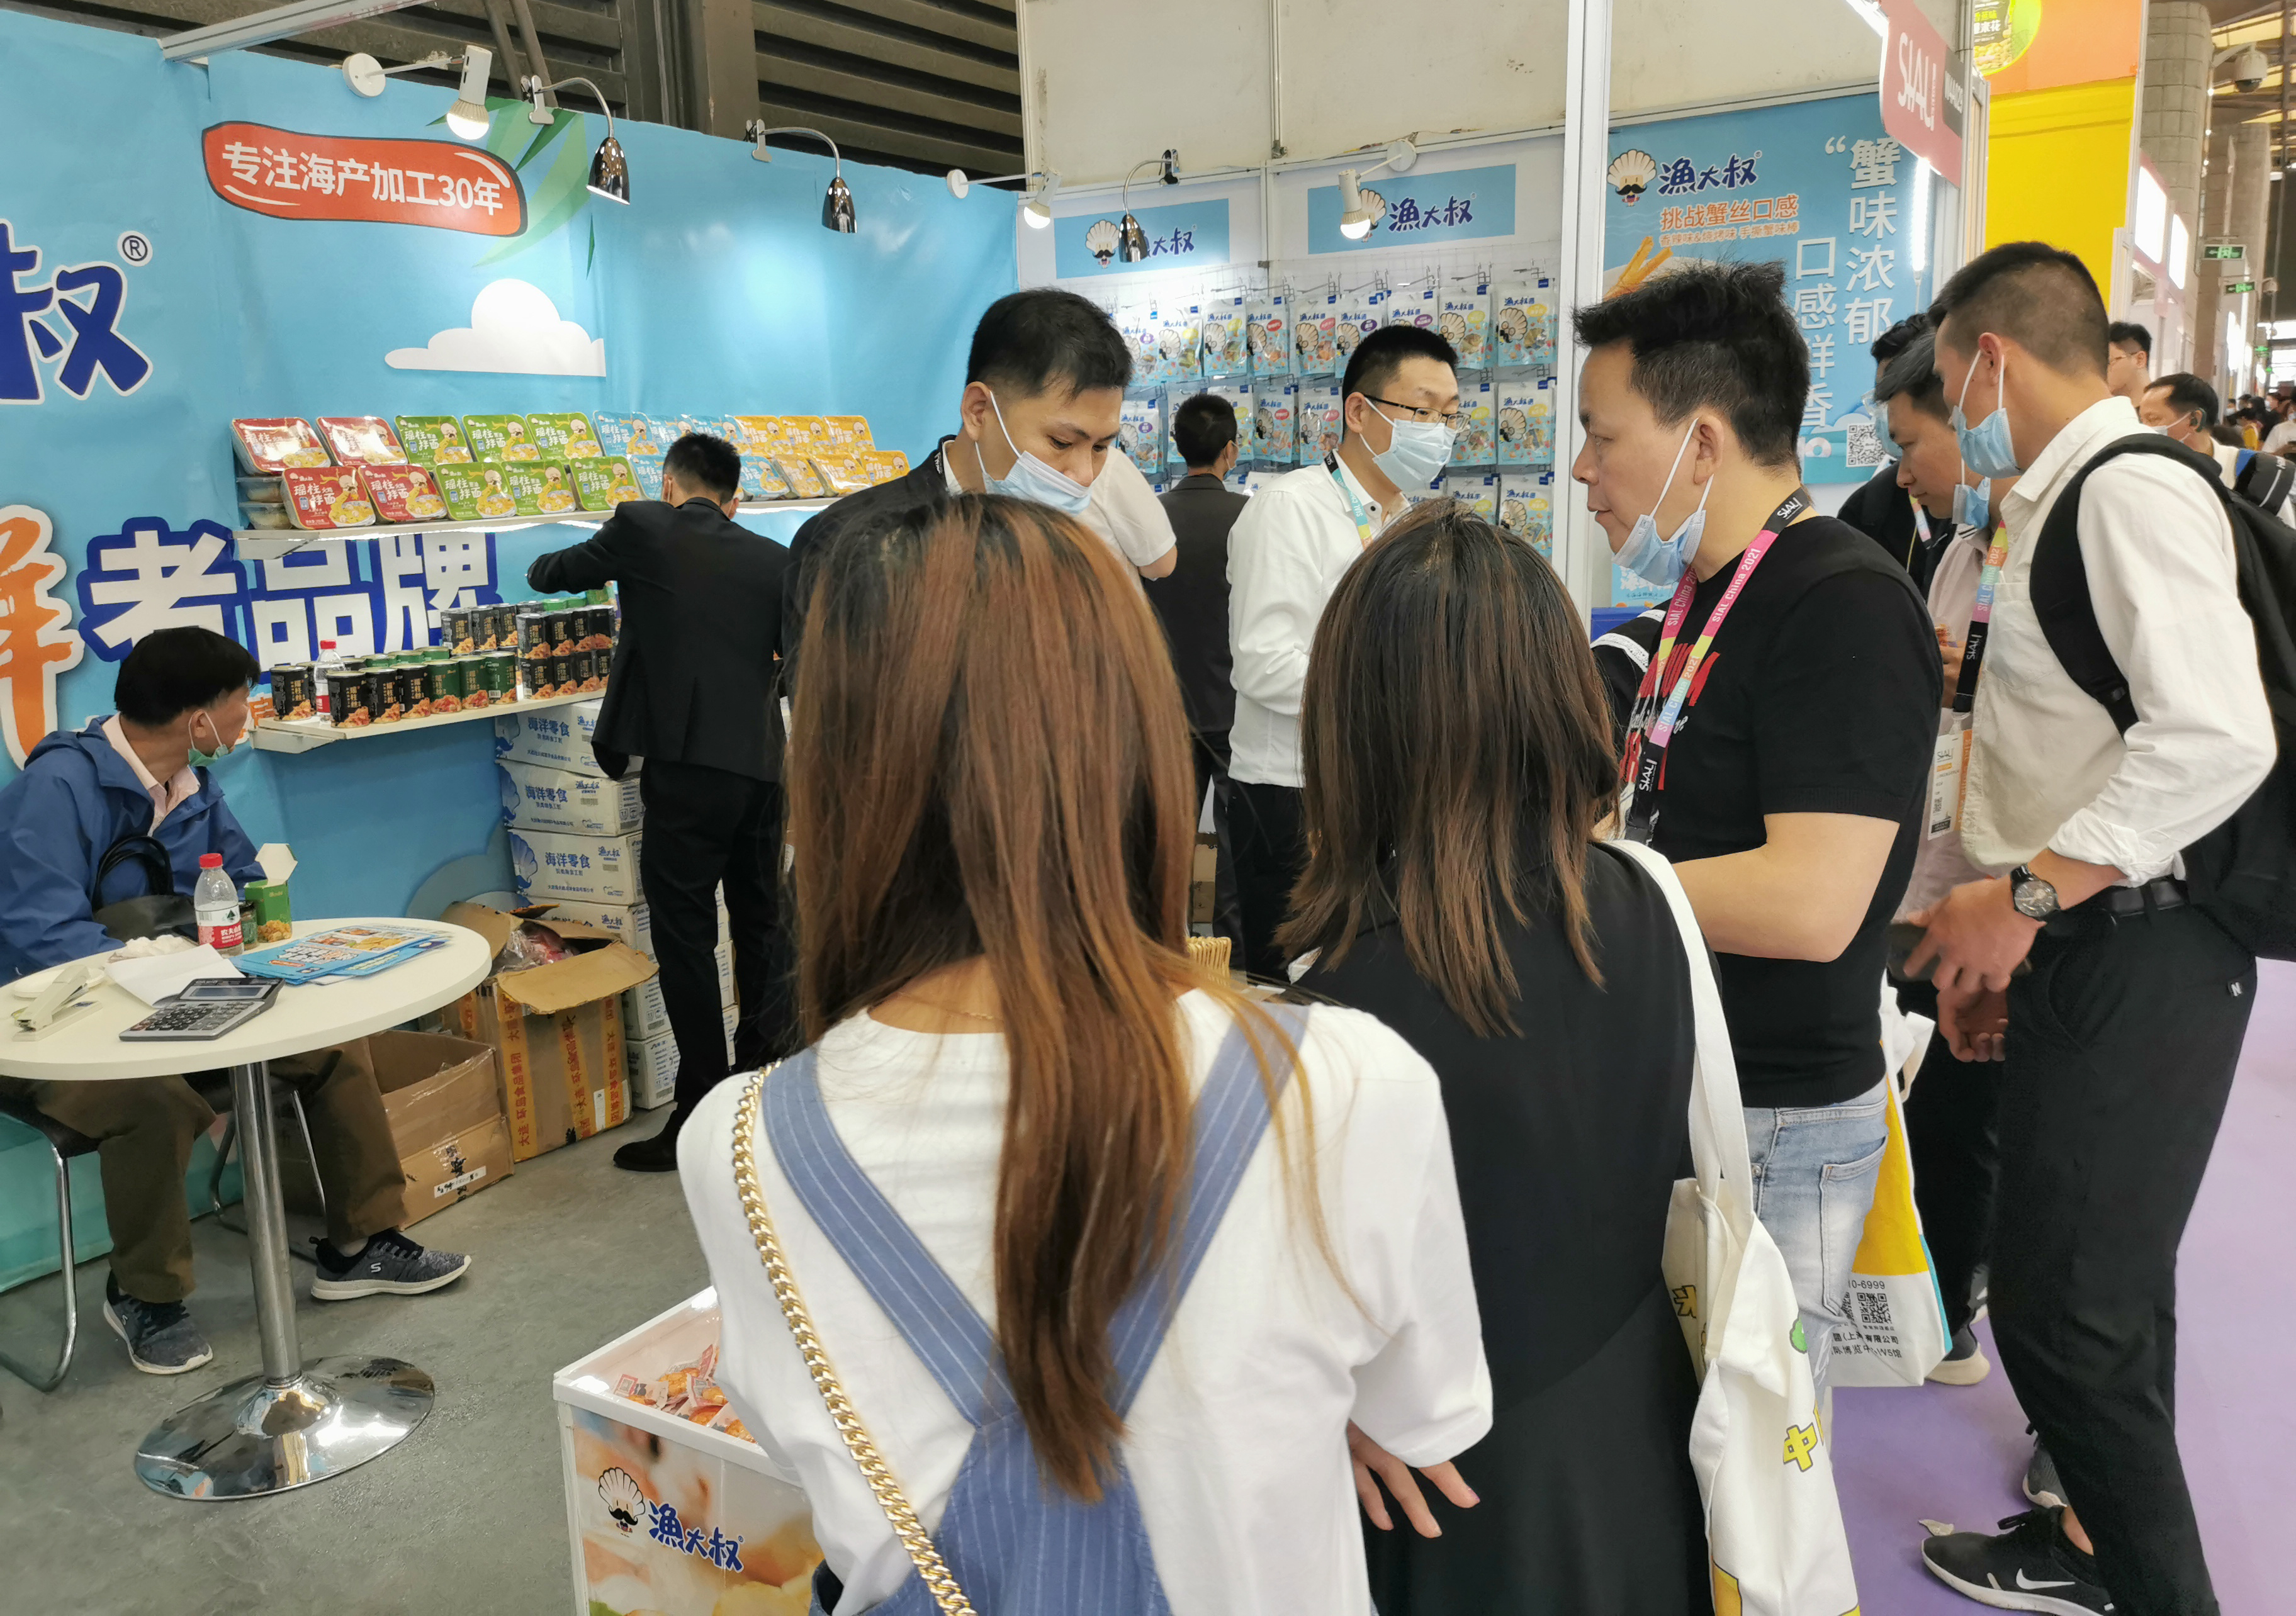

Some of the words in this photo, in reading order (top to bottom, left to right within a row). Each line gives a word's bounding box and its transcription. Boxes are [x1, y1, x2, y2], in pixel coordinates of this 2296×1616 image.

[222, 142, 504, 216] 专注海产加工30年
[1661, 194, 1799, 232] 挑战蟹丝口感
[1141, 228, 1194, 258] 大叔
[1843, 137, 1901, 344] 蟹味浓郁
[1685, 567, 1697, 585] 202
[1712, 603, 1730, 622] SIAL
[1725, 573, 1747, 600] China
[1741, 548, 1761, 571] 2021
[1674, 585, 1692, 607] China
[1667, 610, 1684, 626] SIAL
[1658, 711, 1675, 732] SIAL
[1669, 680, 1688, 709] China
[1684, 655, 1699, 678] 2021
[527, 716, 570, 737] 海洋零食
[525, 784, 568, 803] 海洋零食
[545, 851, 590, 868] 海洋零食
[1783, 1422, 1818, 1472] 中
